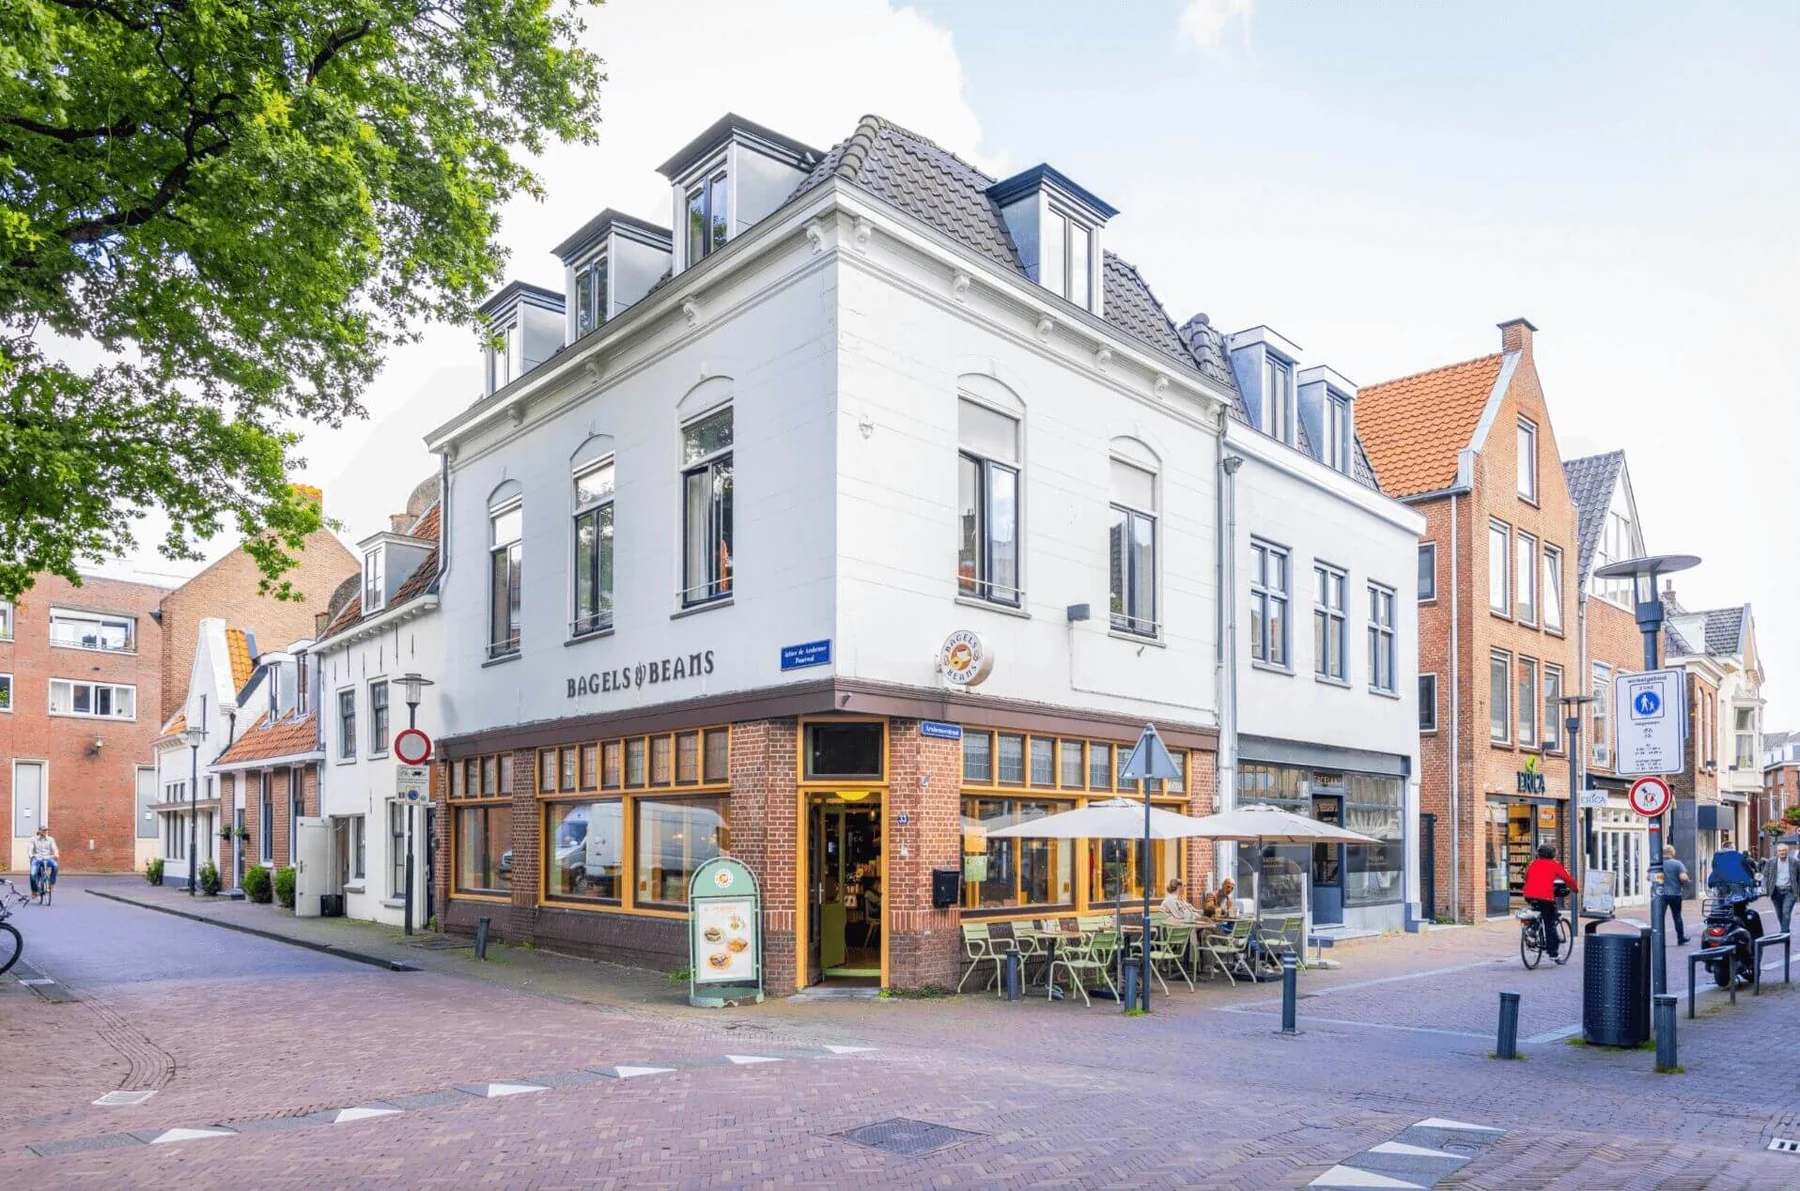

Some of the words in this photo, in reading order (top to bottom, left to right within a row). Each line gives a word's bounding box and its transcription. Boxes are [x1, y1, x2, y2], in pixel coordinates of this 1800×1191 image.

[946, 634, 977, 652] BAGELS
[566, 667, 631, 698] BAGELS
[650, 650, 714, 684] BEANS
[947, 665, 977, 681] BEANS
[1517, 771, 1545, 795] ERICA
[1581, 794, 1606, 804] ERICA
